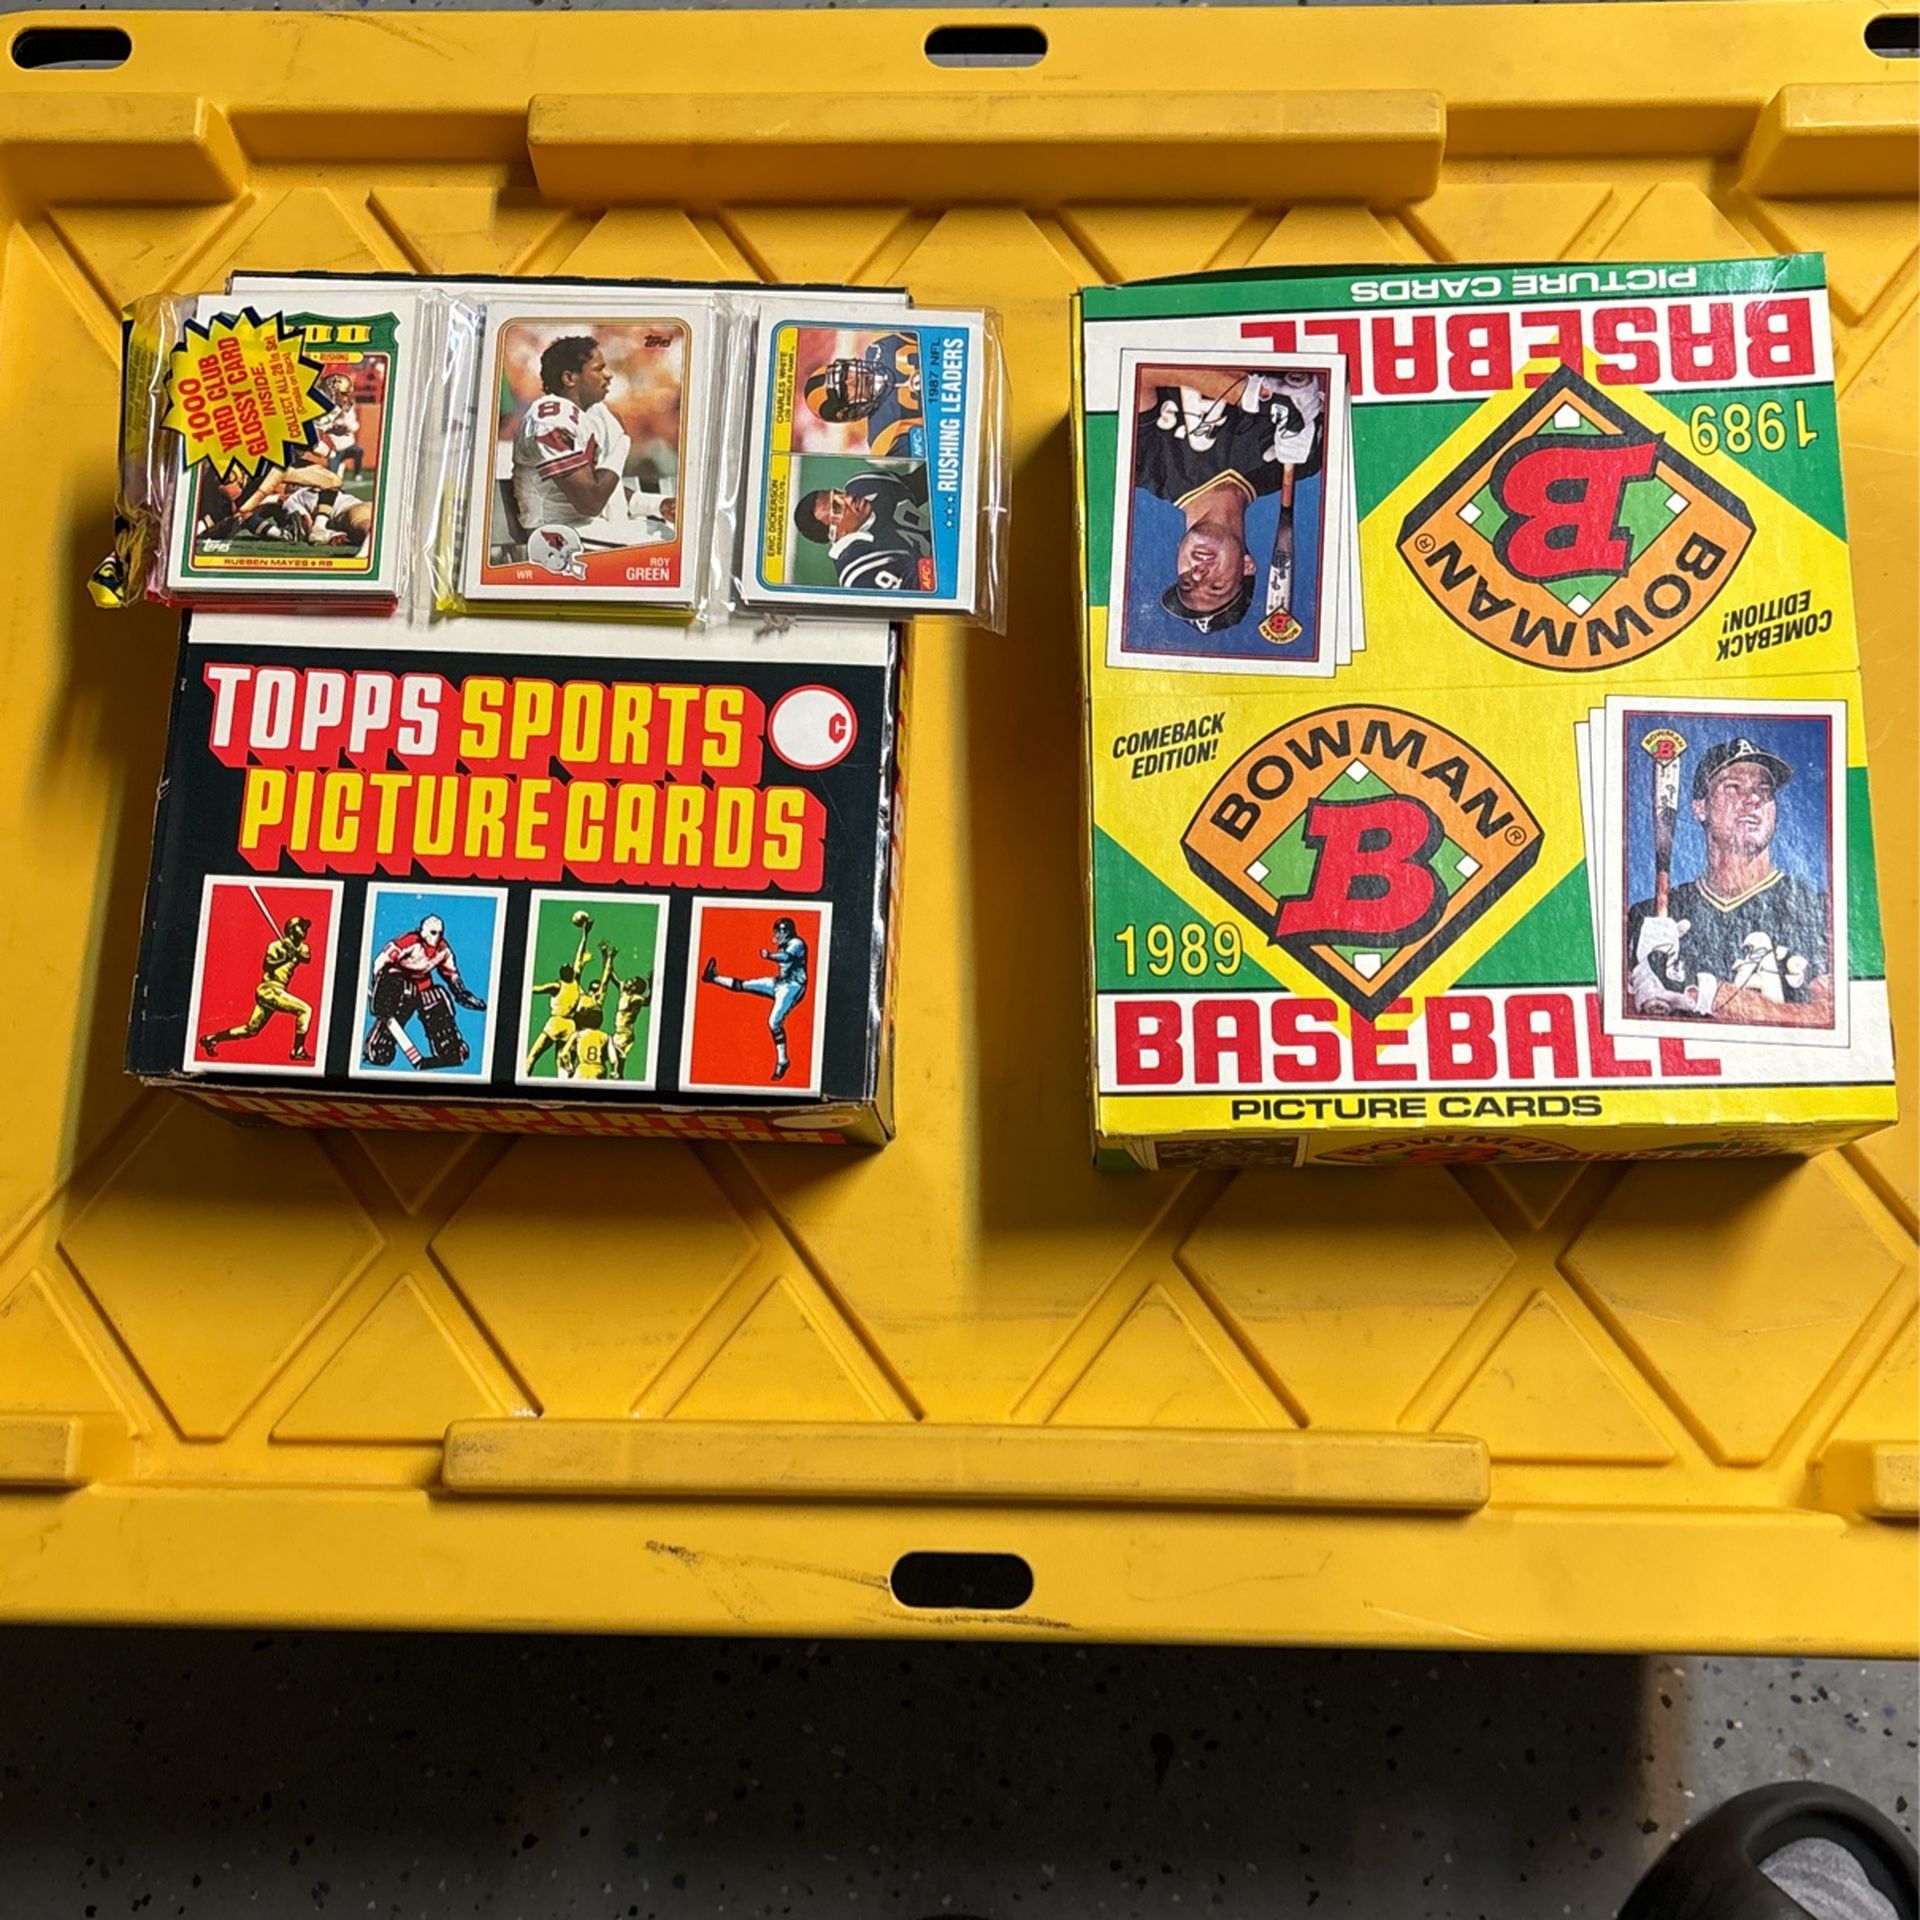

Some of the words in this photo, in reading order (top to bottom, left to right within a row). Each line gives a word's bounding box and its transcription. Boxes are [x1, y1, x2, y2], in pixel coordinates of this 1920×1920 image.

[1351, 274, 1502, 302] CARDS
[1513, 268, 1697, 297] PICTURE
[217, 336, 248, 385] CARD
[779, 352, 788, 379] WHITE
[930, 338, 941, 366] NFL
[941, 337, 964, 413] LEADERS
[198, 354, 228, 402] CLUB
[929, 371, 940, 404] 1987
[178, 378, 214, 442] 1000
[232, 389, 269, 456] GLOSSY
[280, 397, 301, 438] COLLECT
[776, 381, 786, 424] CHARLES
[213, 405, 242, 454] YARD
[1691, 399, 1819, 455] 1989
[937, 418, 960, 492] RUSHING
[768, 480, 779, 533] DICKERSON
[1499, 438, 1661, 580] B
[650, 557, 670, 567] ROY
[767, 535, 776, 557] ERIC
[516, 570, 533, 580] WR
[626, 567, 670, 581] GREEN
[1716, 608, 1833, 661] COMEBACK
[1723, 590, 1811, 635] EDITION!
[208, 667, 443, 756] TOPPS
[461, 679, 746, 767] SPORTS
[1112, 712, 1226, 759] COMEBACK
[1131, 739, 1219, 779] EDITION!
[239, 770, 552, 860] PICTURE
[563, 786, 805, 870] CARDS
[1273, 796, 1440, 940] B
[1115, 922, 1243, 977] 1989
[1231, 1096, 1428, 1120] PICTURE
[1438, 1095, 1602, 1118] CARDS
